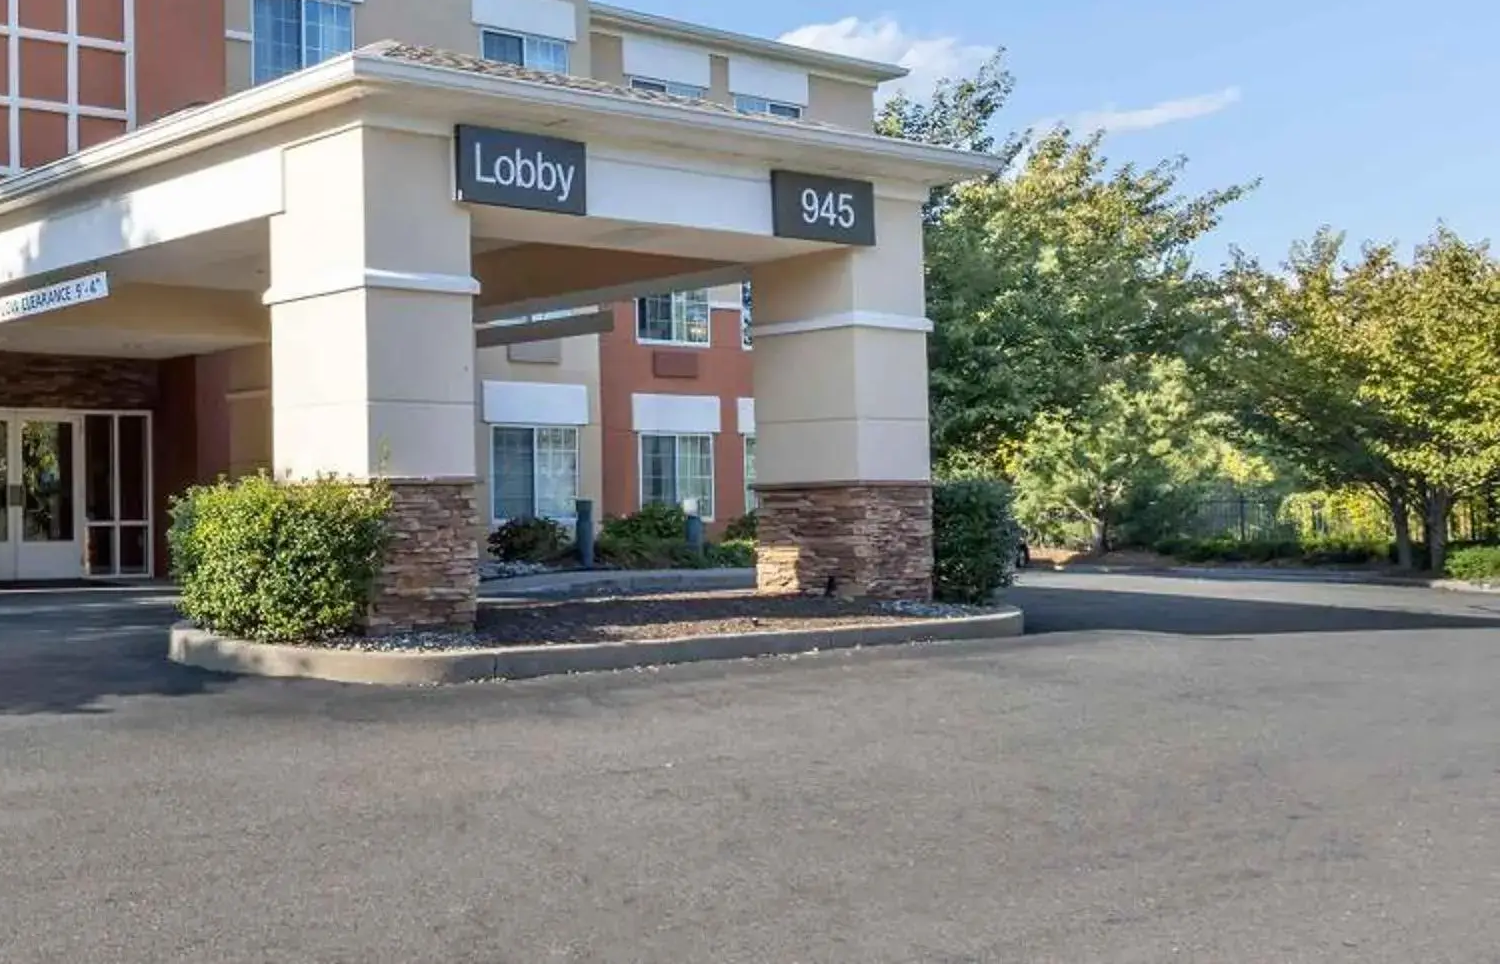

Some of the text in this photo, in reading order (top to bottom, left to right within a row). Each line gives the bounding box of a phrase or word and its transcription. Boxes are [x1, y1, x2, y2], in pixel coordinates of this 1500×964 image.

[474, 142, 575, 202] Lobby
[801, 188, 855, 228] 945
[21, 286, 71, 312] CLEARANCE
